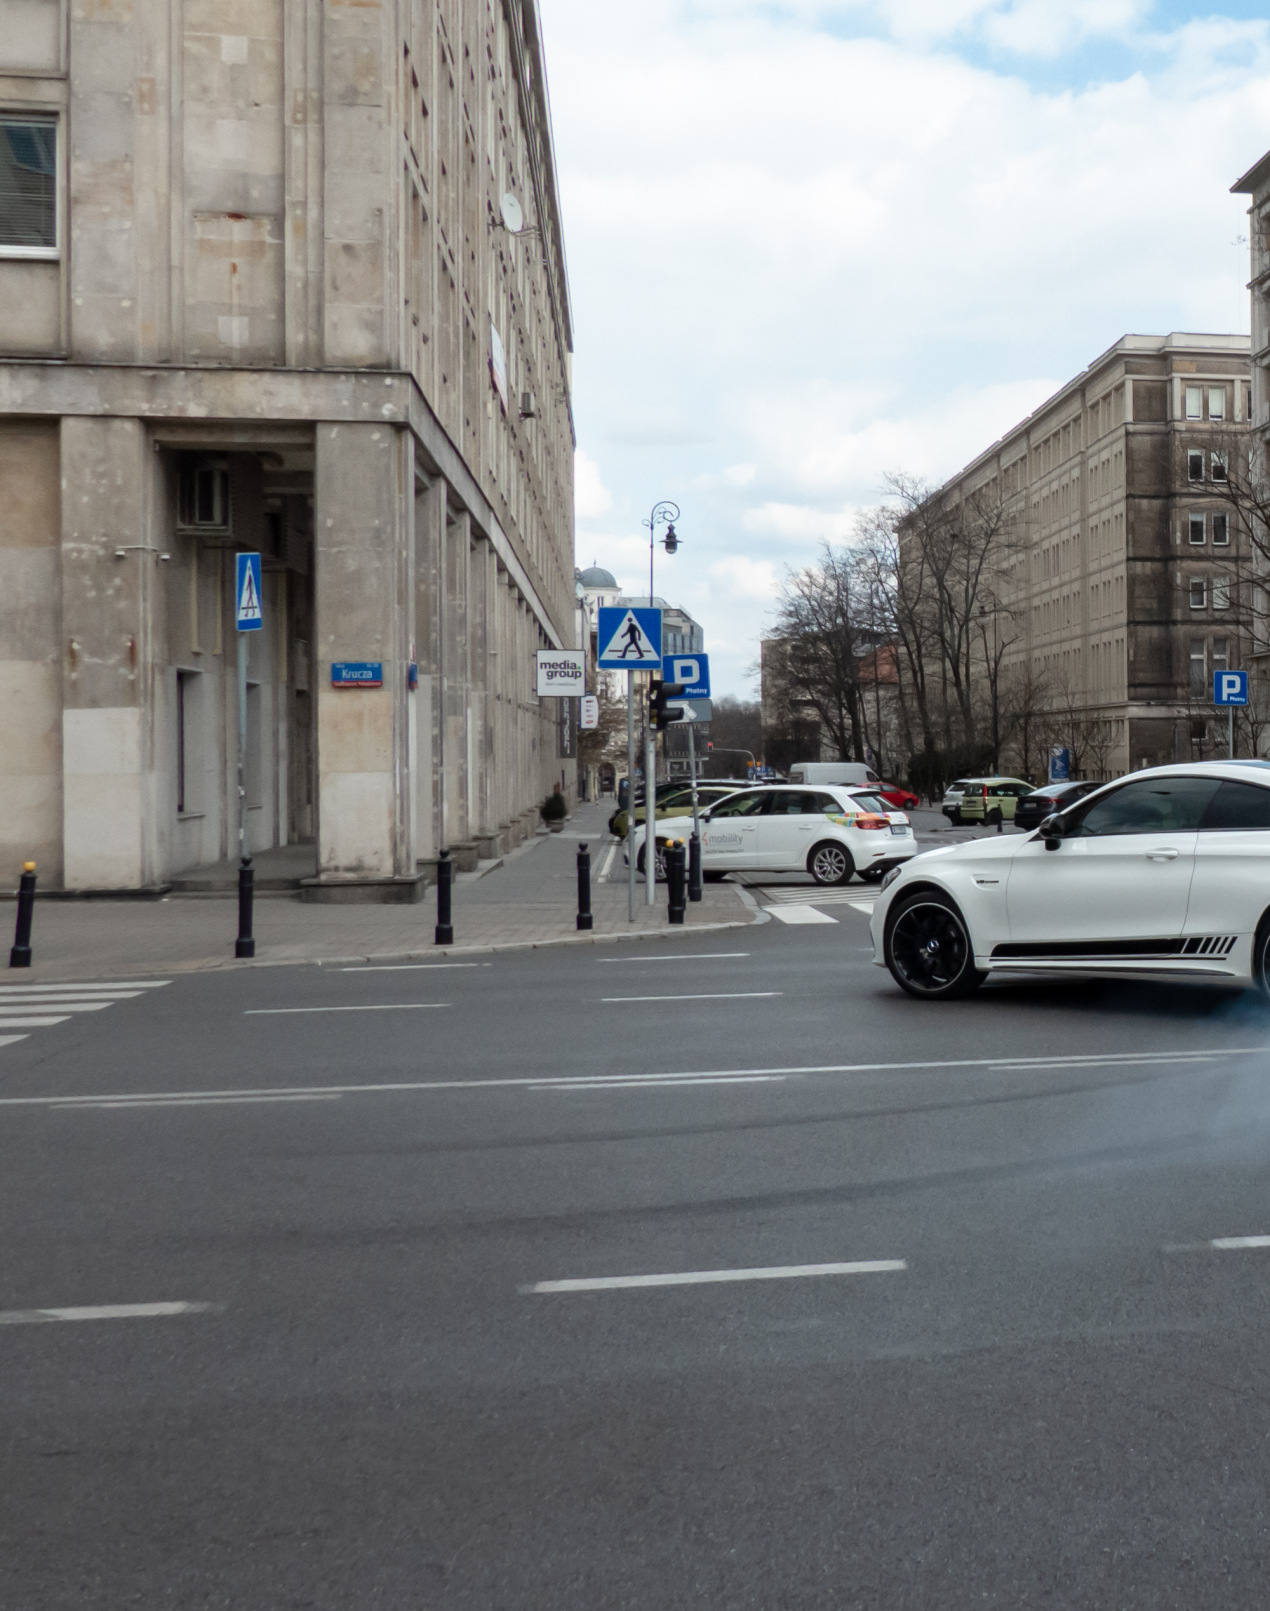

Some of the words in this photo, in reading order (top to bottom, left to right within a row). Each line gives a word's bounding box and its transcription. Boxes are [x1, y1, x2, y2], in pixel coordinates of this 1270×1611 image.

[342, 669, 373, 679] Krucza
[546, 670, 582, 680] group
[1222, 675, 1241, 701] P
